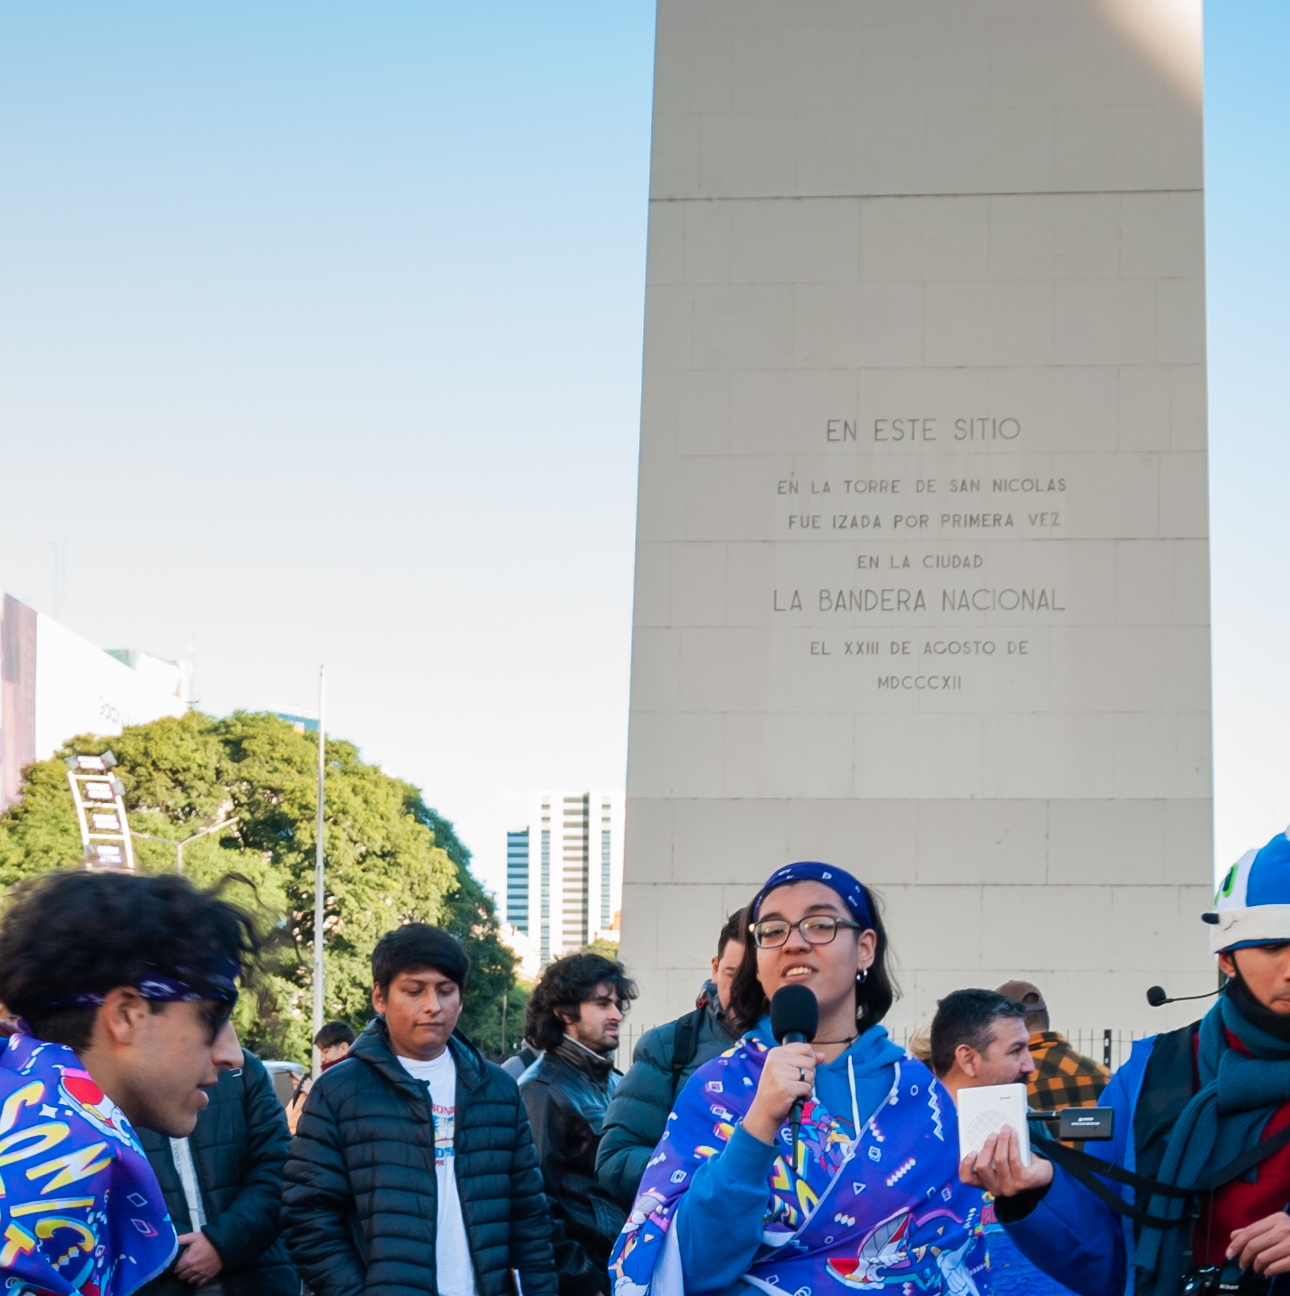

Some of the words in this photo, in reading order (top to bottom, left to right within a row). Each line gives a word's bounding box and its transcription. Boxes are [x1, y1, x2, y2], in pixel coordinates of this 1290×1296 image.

[826, 418, 857, 443] EN
[874, 417, 937, 442] ESTE
[953, 417, 1021, 441] SITIO
[777, 480, 799, 495] EN
[810, 480, 832, 495] LA
[842, 479, 901, 494] TORRE
[915, 478, 937, 494] DE
[949, 478, 981, 493] SAN
[992, 477, 1067, 493] NICOLAS
[788, 514, 822, 530] FUE
[832, 514, 882, 530] IZADA
[892, 513, 930, 530] POR
[940, 512, 1015, 529] PRIMERA
[1027, 511, 1061, 527] VEZ
[856, 554, 880, 570] EN
[889, 554, 911, 570] LA
[922, 553, 984, 569] CIUDAD
[773, 588, 803, 613] LA
[818, 588, 927, 613] BANDERA
[941, 587, 1066, 613] NACIONAL
[809, 640, 832, 656] EL
[843, 640, 880, 656] XXIII
[889, 640, 912, 656] DE
[922, 640, 997, 656] AGOSTO
[1006, 640, 1029, 656] DE
[877, 675, 962, 690] MDCCCXII
